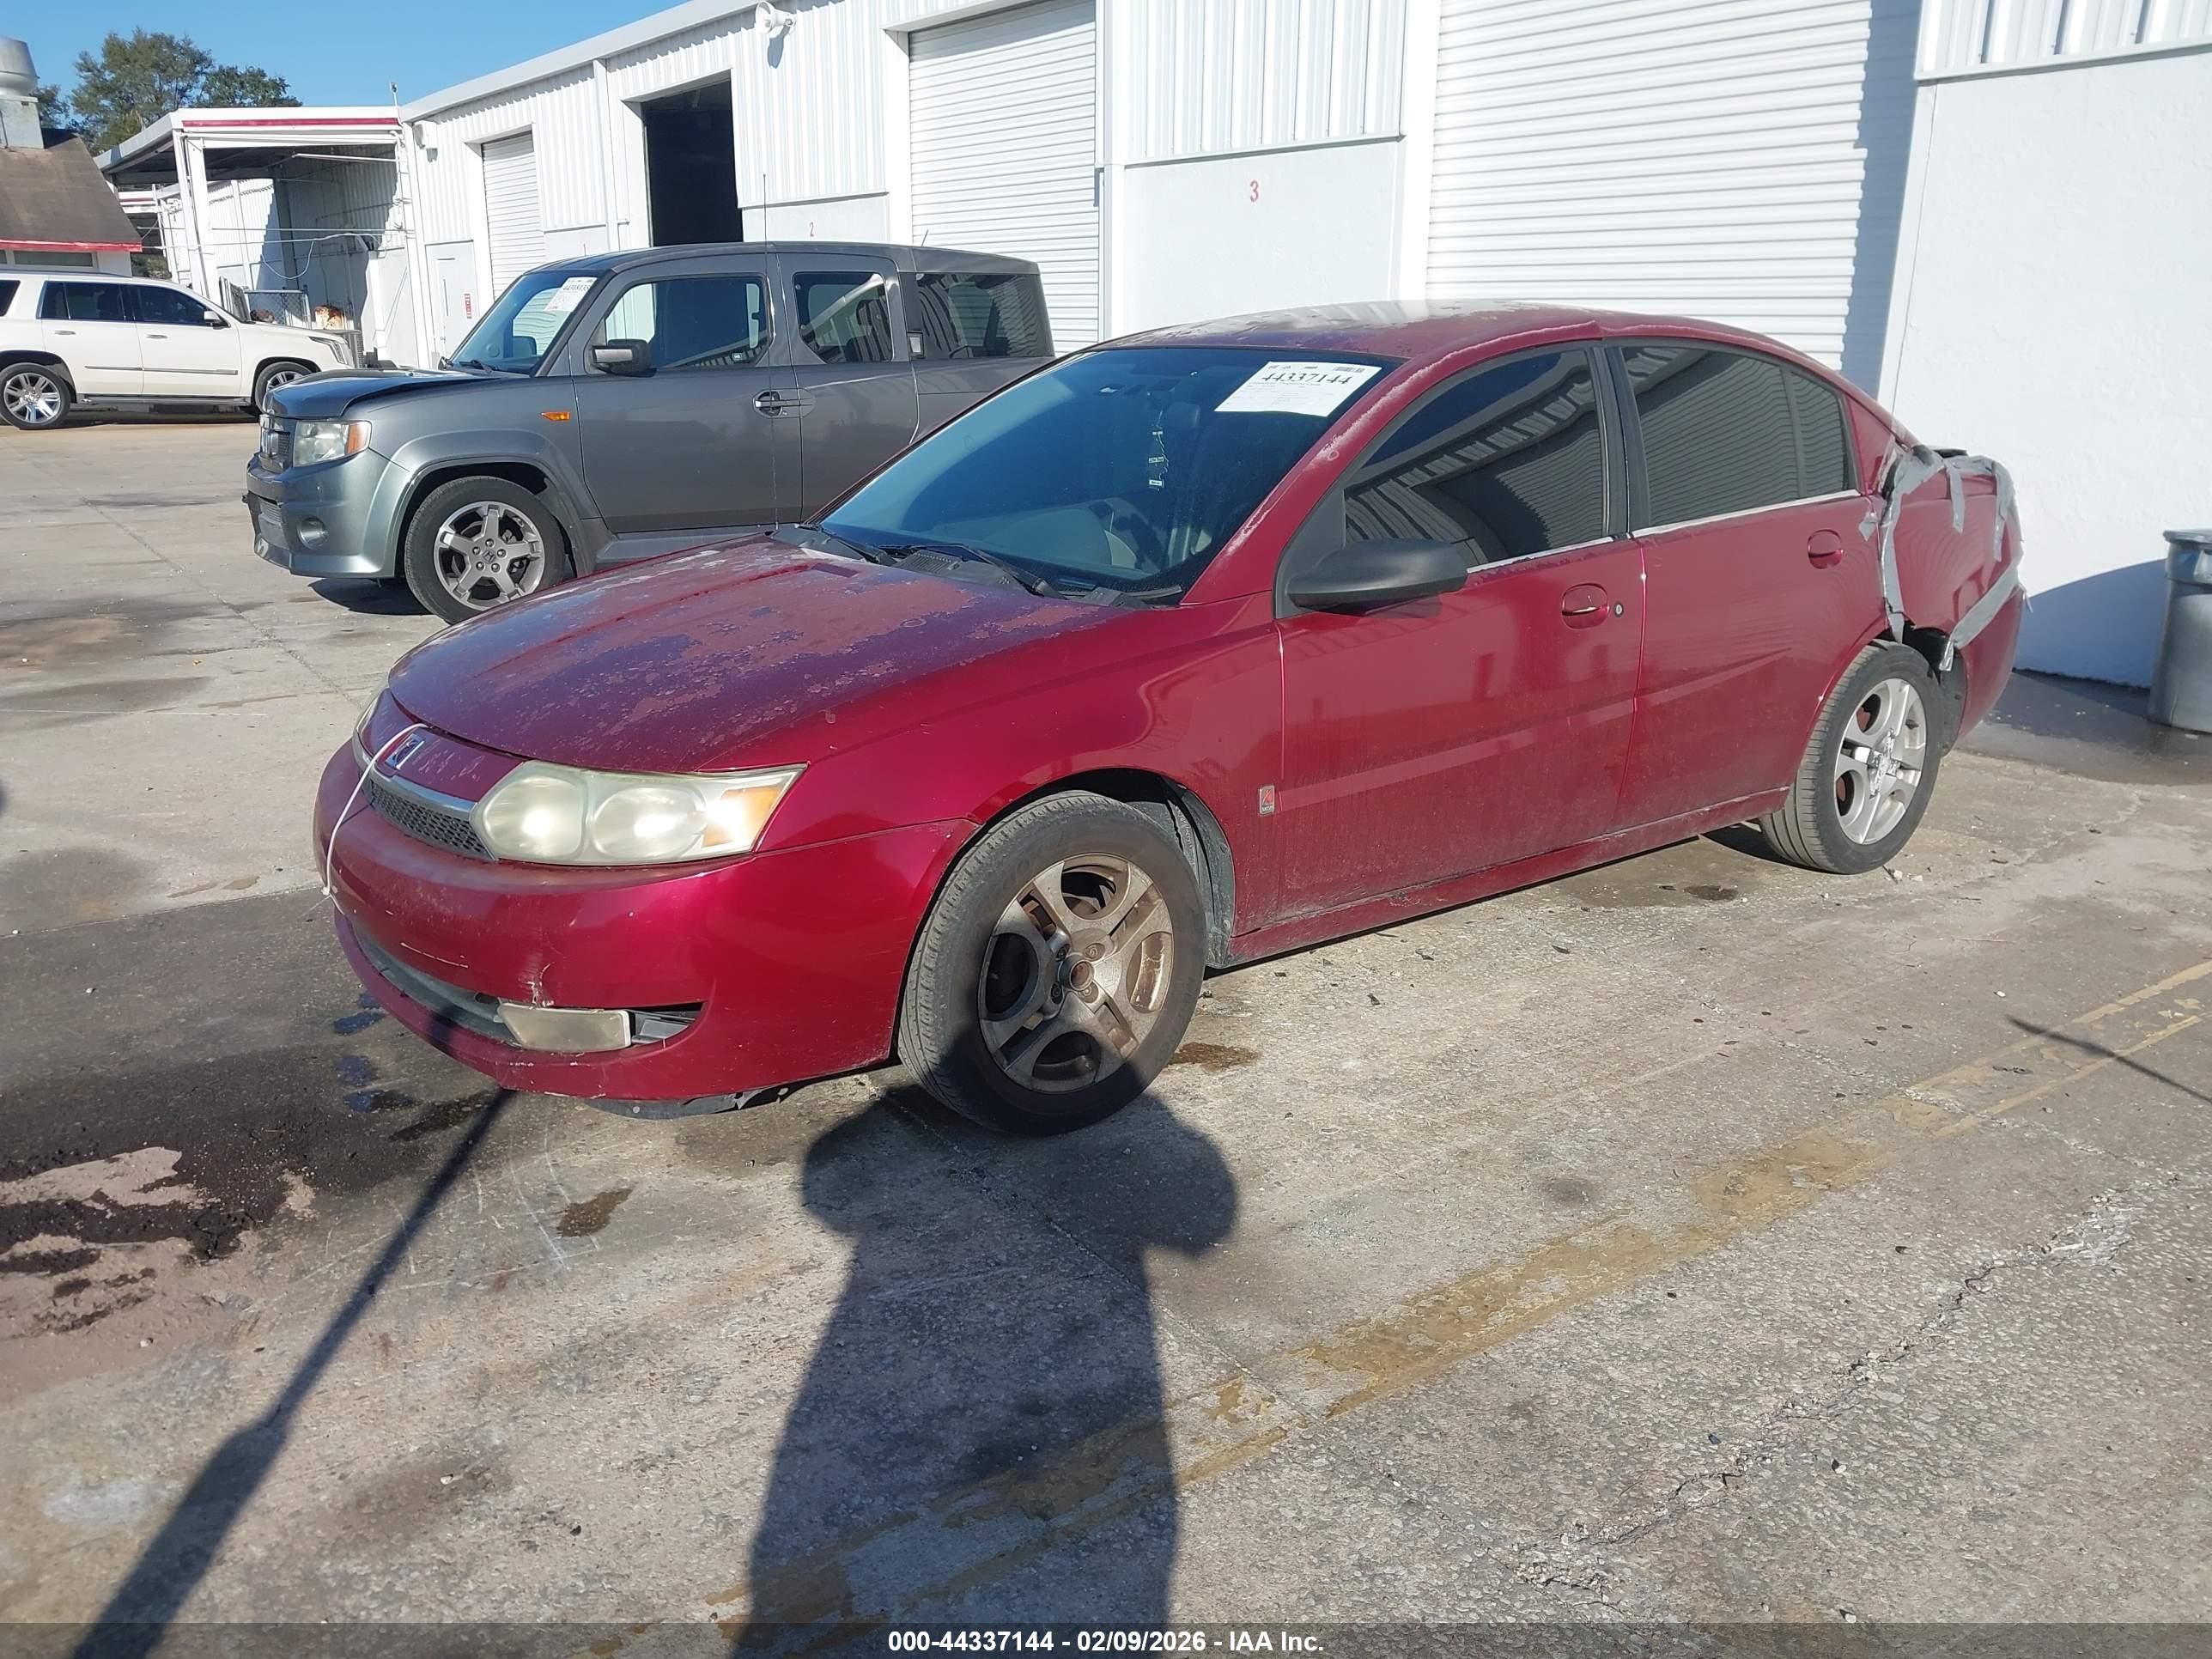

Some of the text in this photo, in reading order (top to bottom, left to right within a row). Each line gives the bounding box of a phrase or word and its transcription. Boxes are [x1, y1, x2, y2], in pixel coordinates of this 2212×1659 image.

[1249, 179, 1259, 203] 3
[809, 222, 815, 237] 2
[1261, 372, 1352, 385] 44337144
